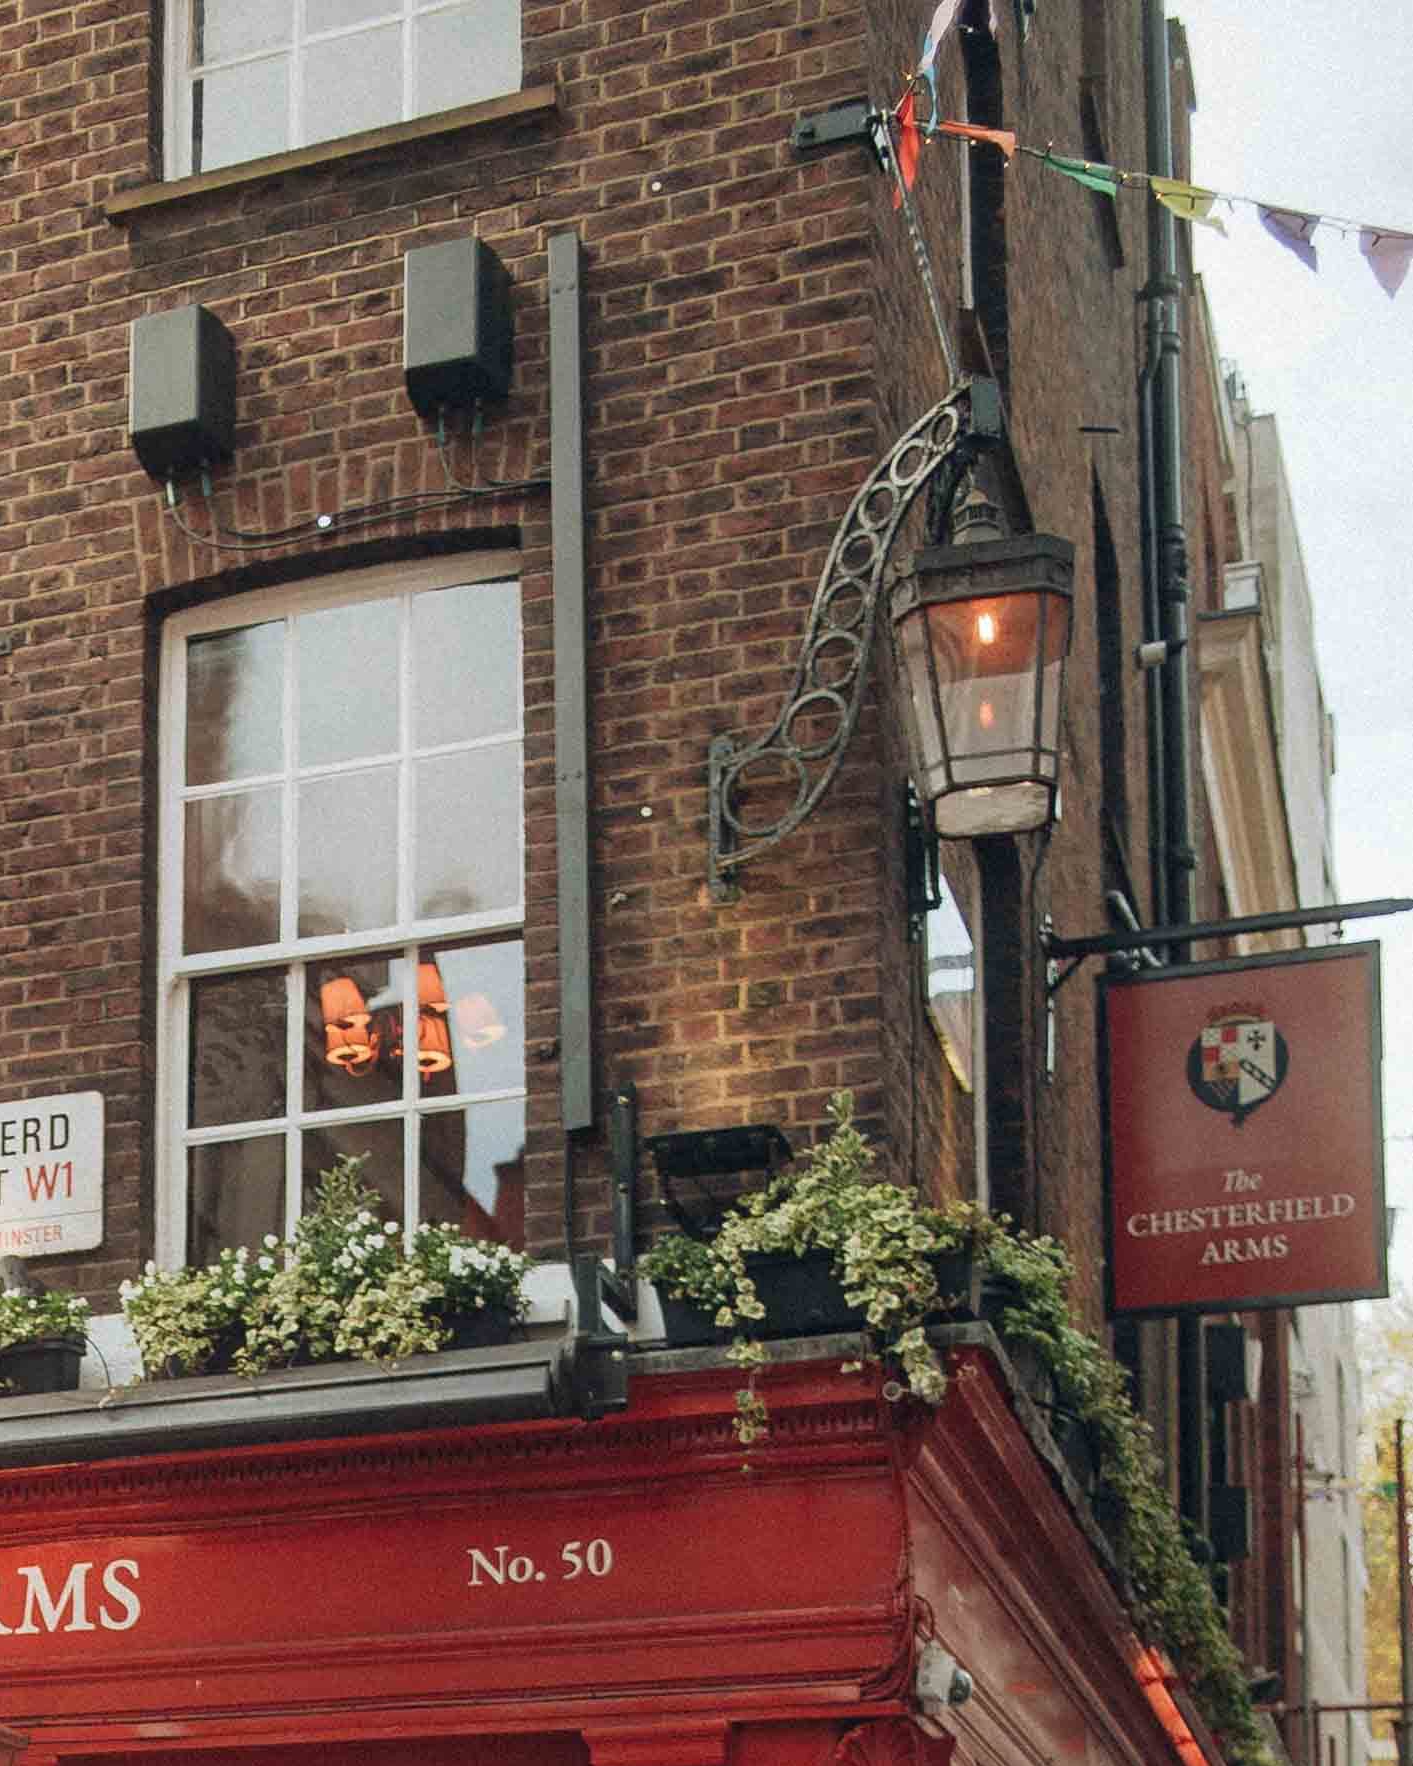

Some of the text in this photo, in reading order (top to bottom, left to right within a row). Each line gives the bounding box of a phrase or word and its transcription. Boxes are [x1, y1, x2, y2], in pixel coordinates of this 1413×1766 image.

[26, 1161, 74, 1201] W1
[1222, 1168, 1263, 1193] The
[1126, 1192, 1356, 1239] CHESTERFIELD
[1200, 1234, 1291, 1265] ARMS
[466, 1538, 613, 1587] No. 50
